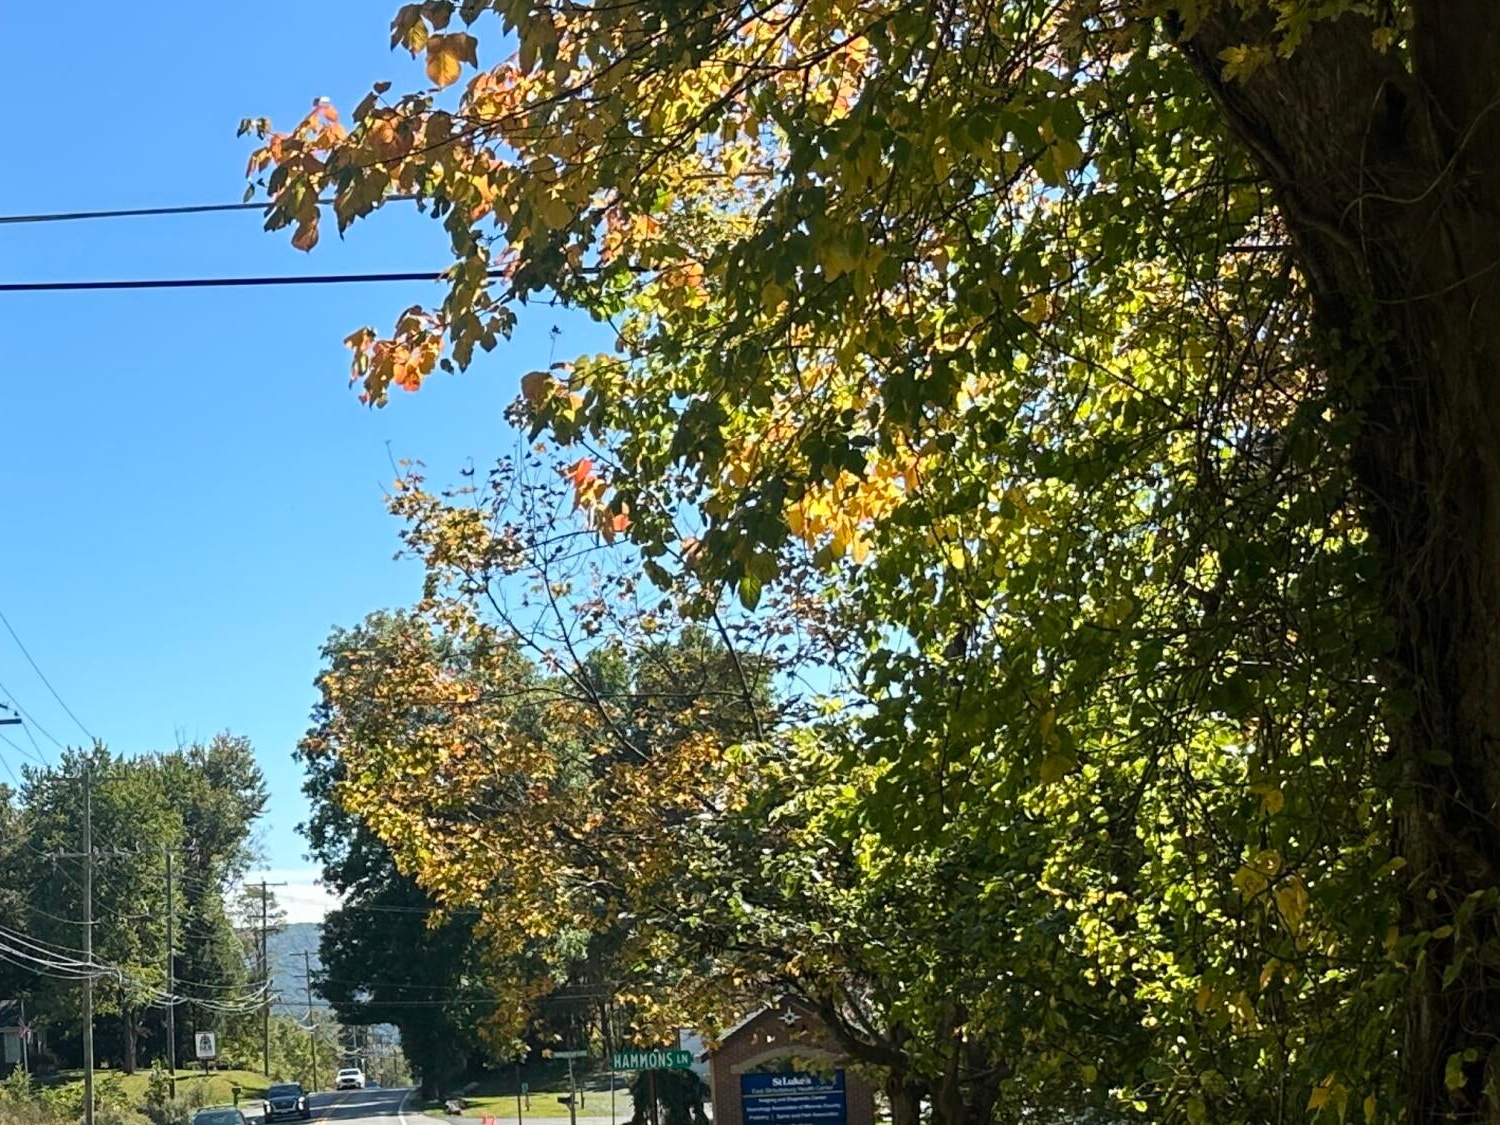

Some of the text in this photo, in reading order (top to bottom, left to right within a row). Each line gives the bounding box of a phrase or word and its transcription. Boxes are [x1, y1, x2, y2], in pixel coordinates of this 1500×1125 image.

[613, 1052, 689, 1069] HAMMONS LN
[783, 1077, 811, 1086] Lukes
